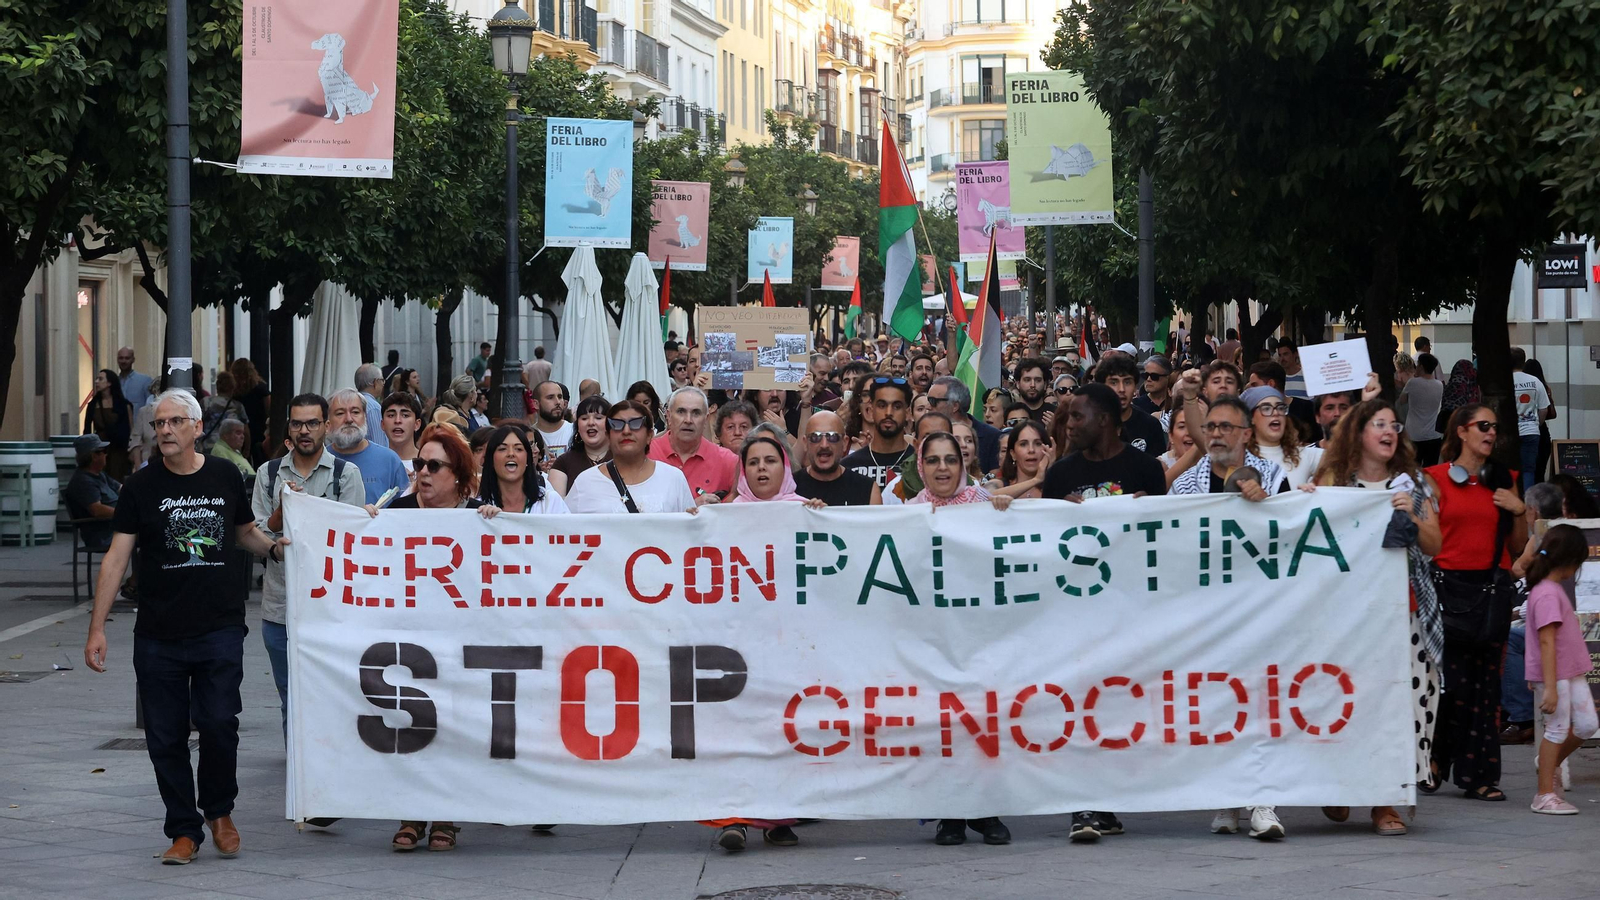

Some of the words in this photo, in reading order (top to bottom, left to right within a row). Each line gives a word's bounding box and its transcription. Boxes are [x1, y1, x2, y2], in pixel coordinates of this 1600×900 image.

[1011, 79, 1049, 91] FERIA
[1012, 93, 1036, 104] DEL
[1040, 91, 1079, 103] LIBRO
[551, 125, 583, 135] FERIA
[551, 136, 571, 146] DEL
[575, 137, 607, 147] LIBRO
[959, 168, 983, 176] FERIA
[977, 175, 1002, 183] LIBRO
[705, 310, 726, 322] NO
[731, 311, 753, 320] VEO
[1519, 381, 1536, 389] NATURE
[159, 495, 210, 511] Andalucía
[211, 497, 225, 506] con
[171, 507, 218, 521] Palestina
[310, 528, 604, 609] JEREZ
[624, 544, 777, 604] CON
[796, 507, 1350, 608] PALESTINA
[357, 641, 748, 760] STOP
[783, 661, 1355, 758] GENOCIDIO
